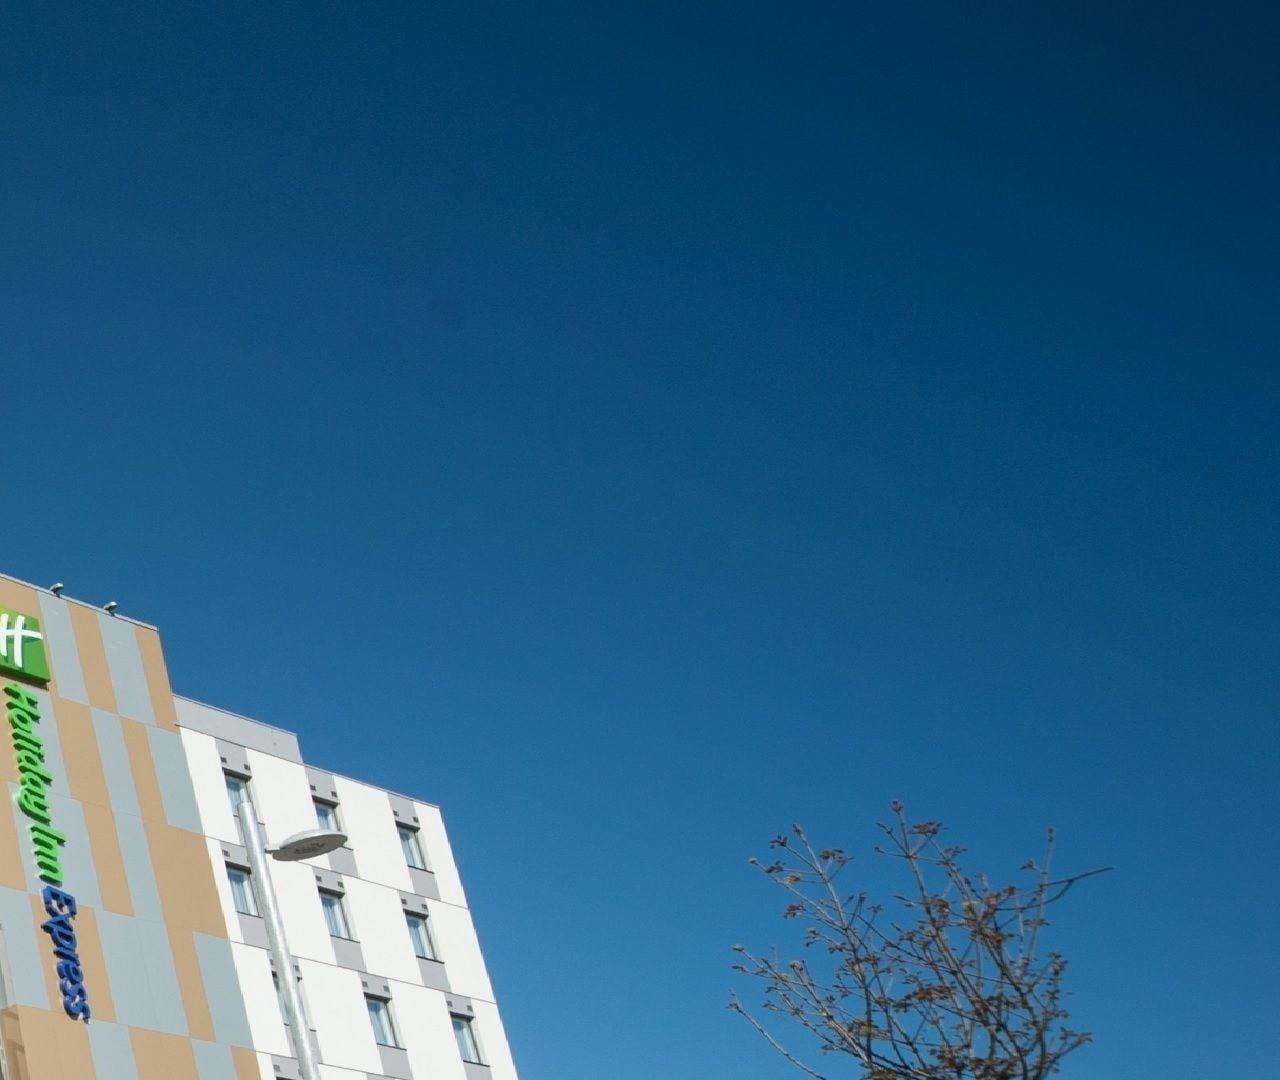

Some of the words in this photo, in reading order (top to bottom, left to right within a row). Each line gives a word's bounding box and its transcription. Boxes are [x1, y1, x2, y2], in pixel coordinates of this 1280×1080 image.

[2, 682, 53, 825] Holiday
[28, 823, 66, 888] Inn
[40, 885, 91, 1024] Express
